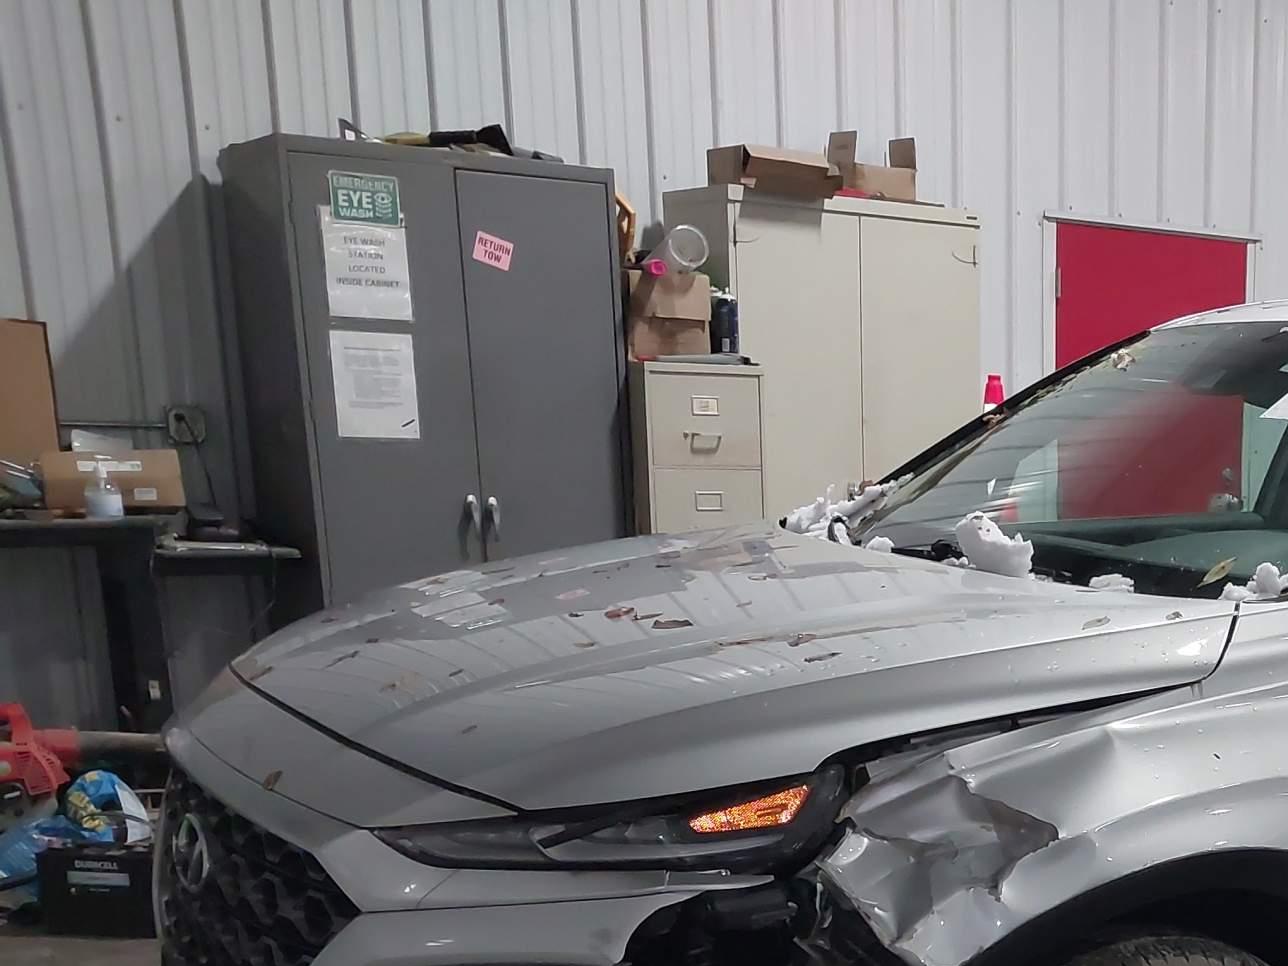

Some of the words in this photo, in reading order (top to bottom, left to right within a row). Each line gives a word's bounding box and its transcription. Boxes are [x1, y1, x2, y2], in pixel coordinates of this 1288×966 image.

[332, 174, 395, 191] EMERGENCY
[337, 189, 374, 209] EYE
[338, 207, 374, 219] WASH
[343, 236, 358, 246] EYE
[359, 237, 386, 247] WASH
[477, 236, 511, 257] RETURN
[348, 250, 384, 261] STATION
[482, 249, 502, 264] TOW
[348, 264, 386, 274] LOCATED
[335, 277, 363, 288] INSIDE
[365, 278, 400, 289] CABINET
